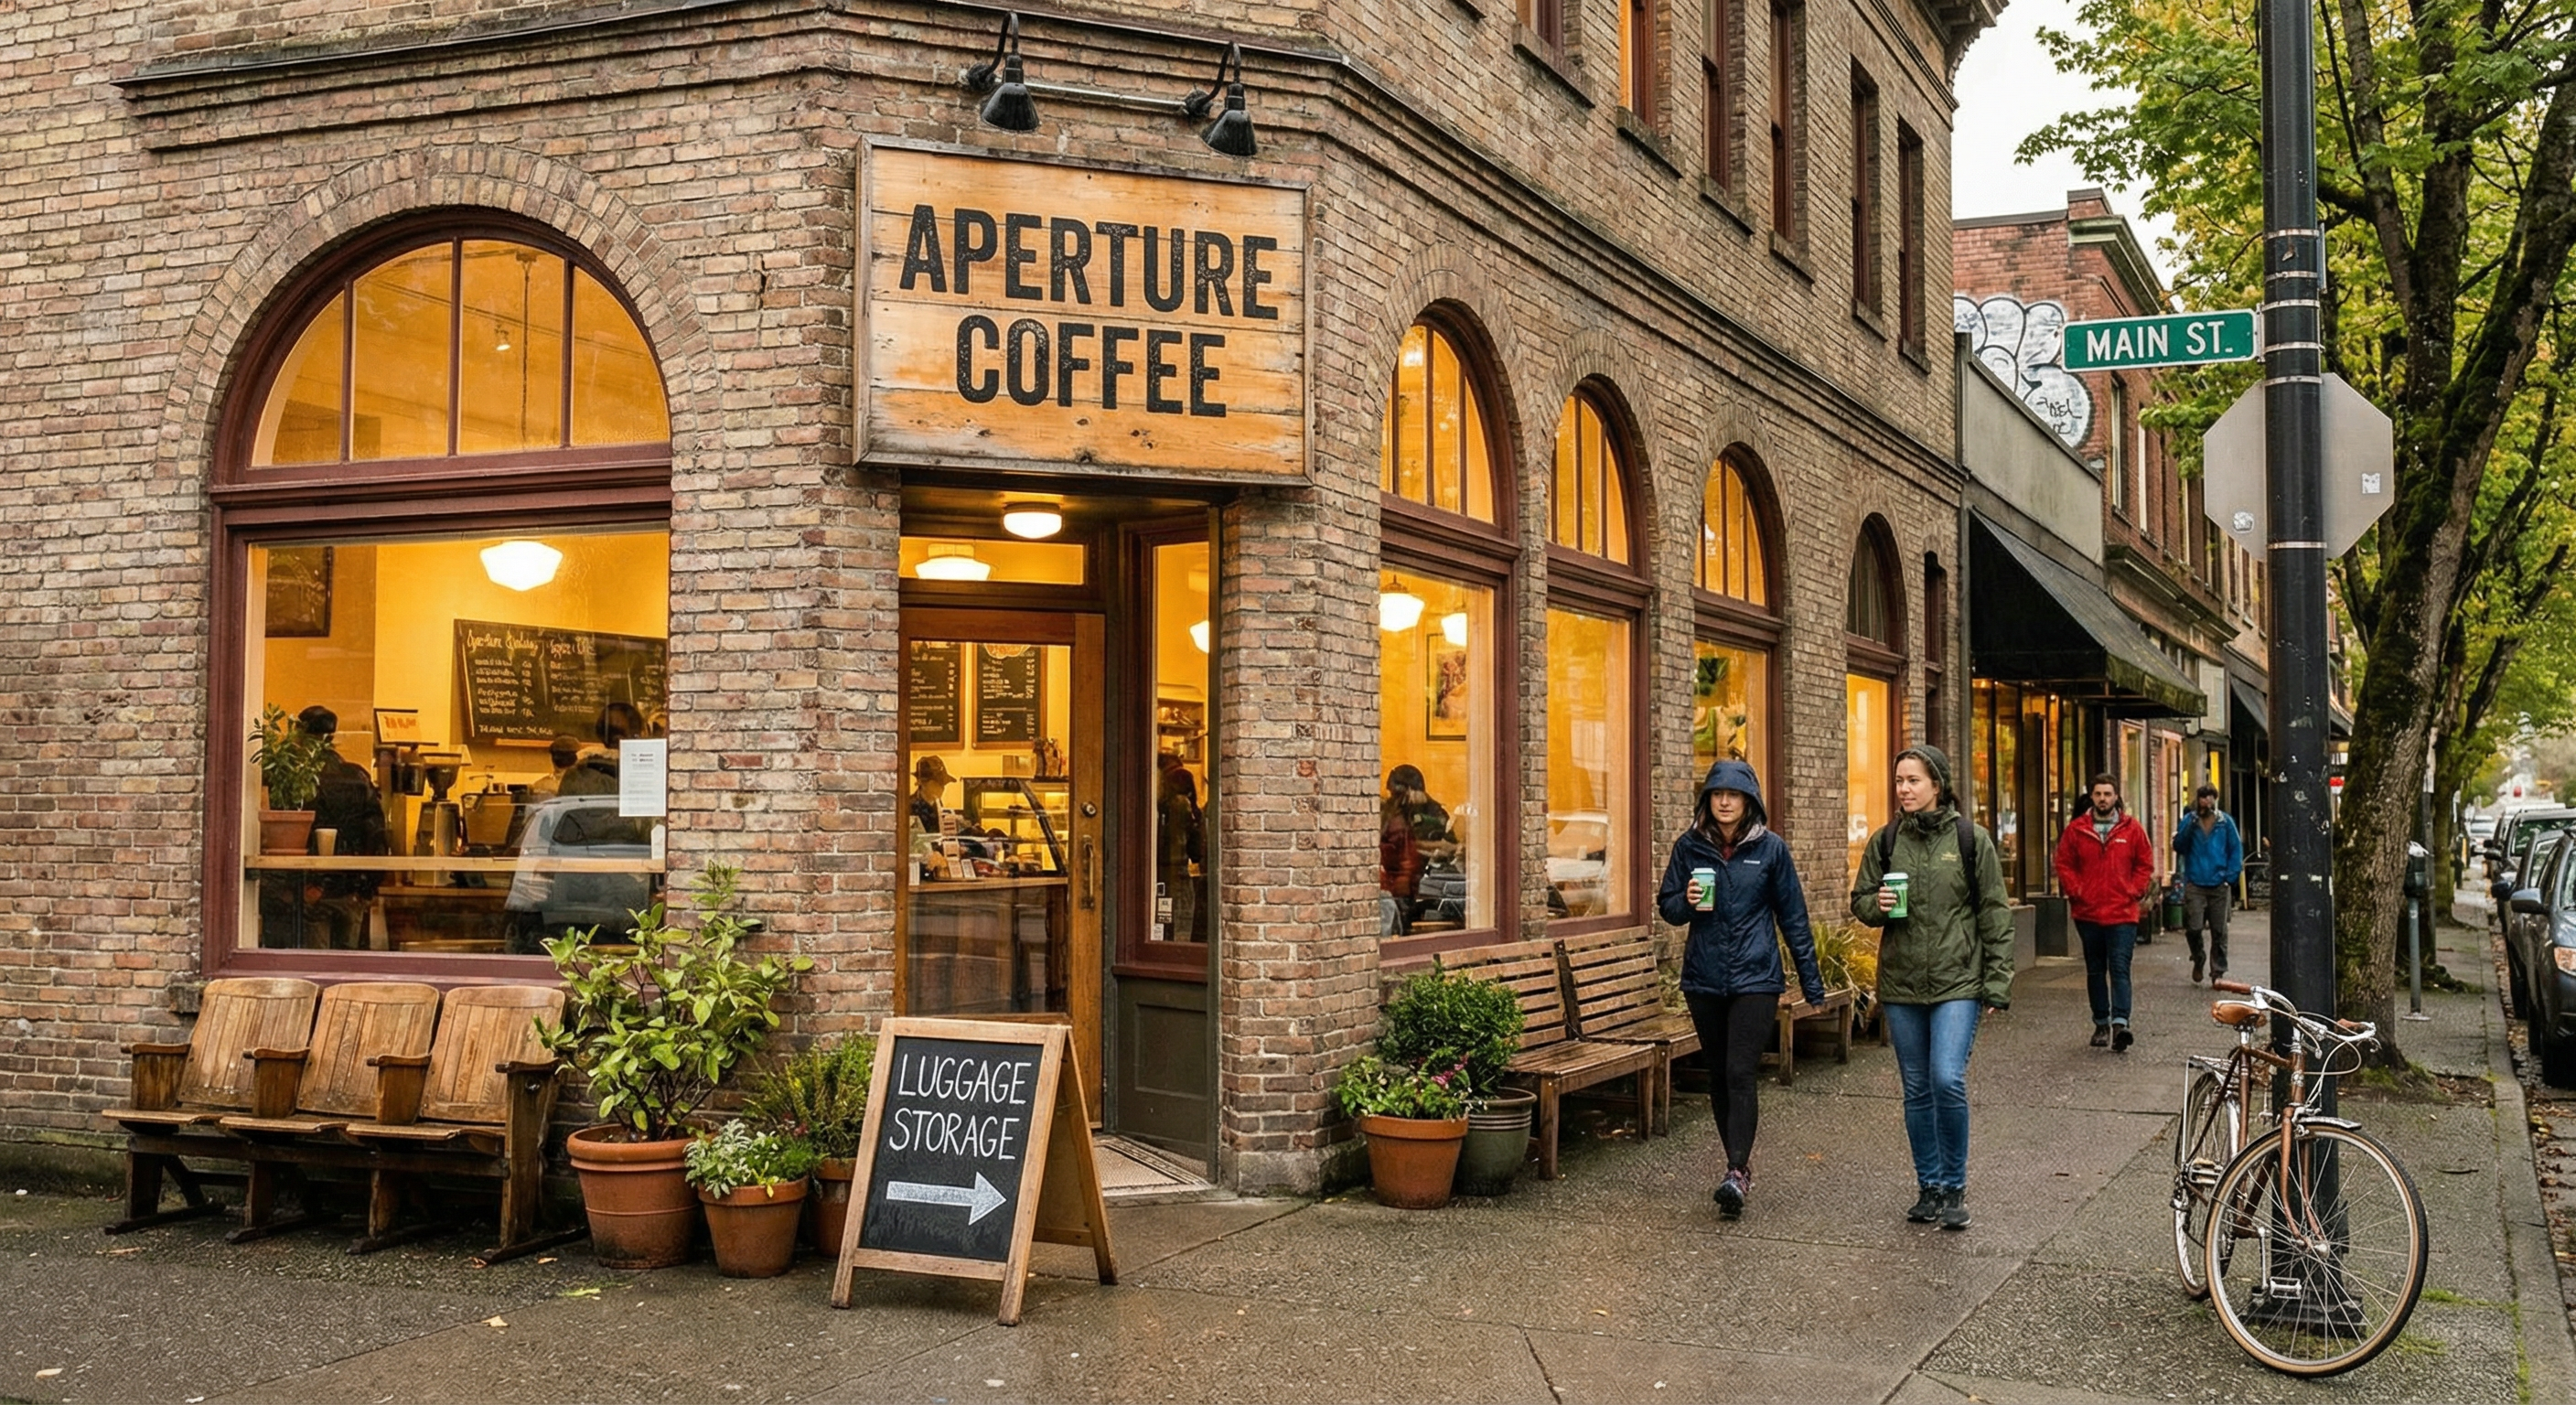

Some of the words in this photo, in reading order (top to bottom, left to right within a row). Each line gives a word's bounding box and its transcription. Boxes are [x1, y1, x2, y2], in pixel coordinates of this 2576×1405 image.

[898, 204, 1279, 320] APERTURE
[956, 314, 1227, 418] COFFEE
[2087, 325, 2168, 362] MAIN
[898, 1054, 1032, 1104] LUGGAGE
[889, 1108, 1020, 1160] STORAGE
